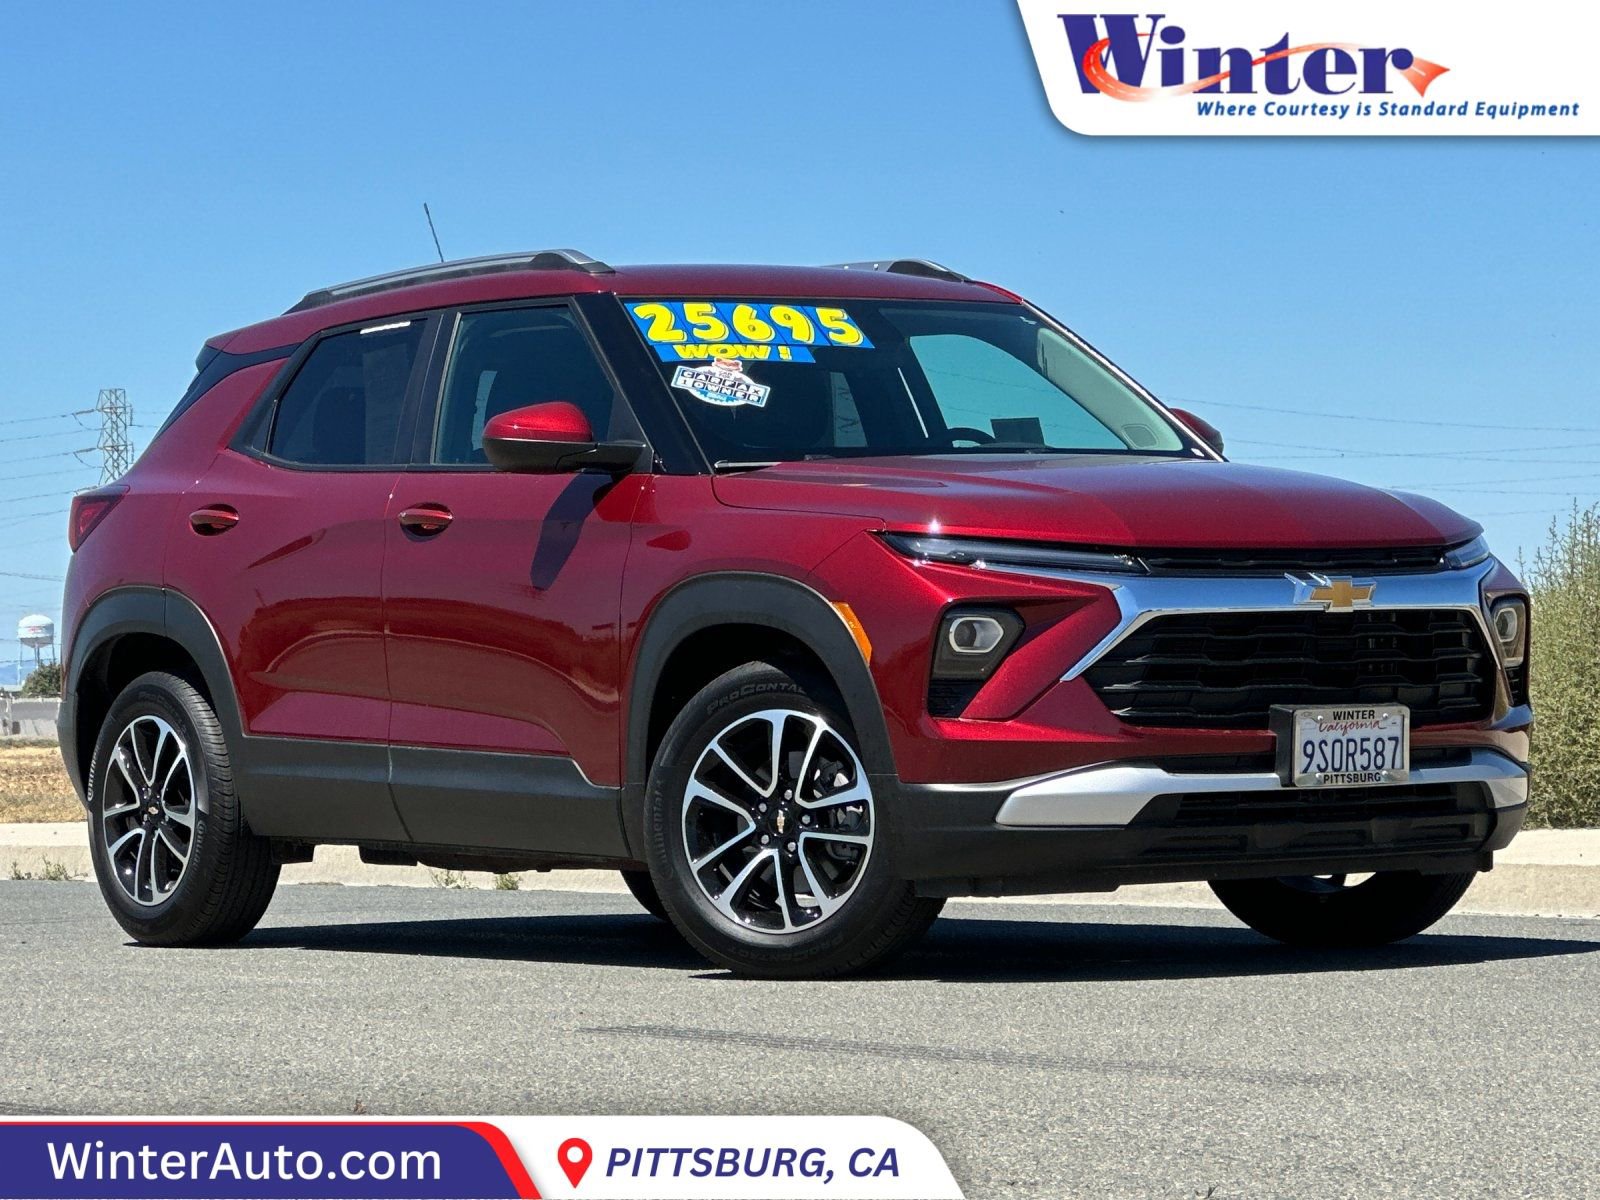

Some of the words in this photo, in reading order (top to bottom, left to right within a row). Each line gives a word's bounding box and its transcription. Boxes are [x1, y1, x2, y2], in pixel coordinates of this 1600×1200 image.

[633, 302, 864, 345] 25695
[672, 344, 772, 360] WOW
[680, 369, 763, 396] CARFAX
[691, 380, 763, 403] OWNER
[1333, 710, 1375, 721] WINTER
[1318, 719, 1387, 737] California
[1302, 736, 1399, 774] 9SOR587
[1323, 772, 1382, 784] PITTSBURG
